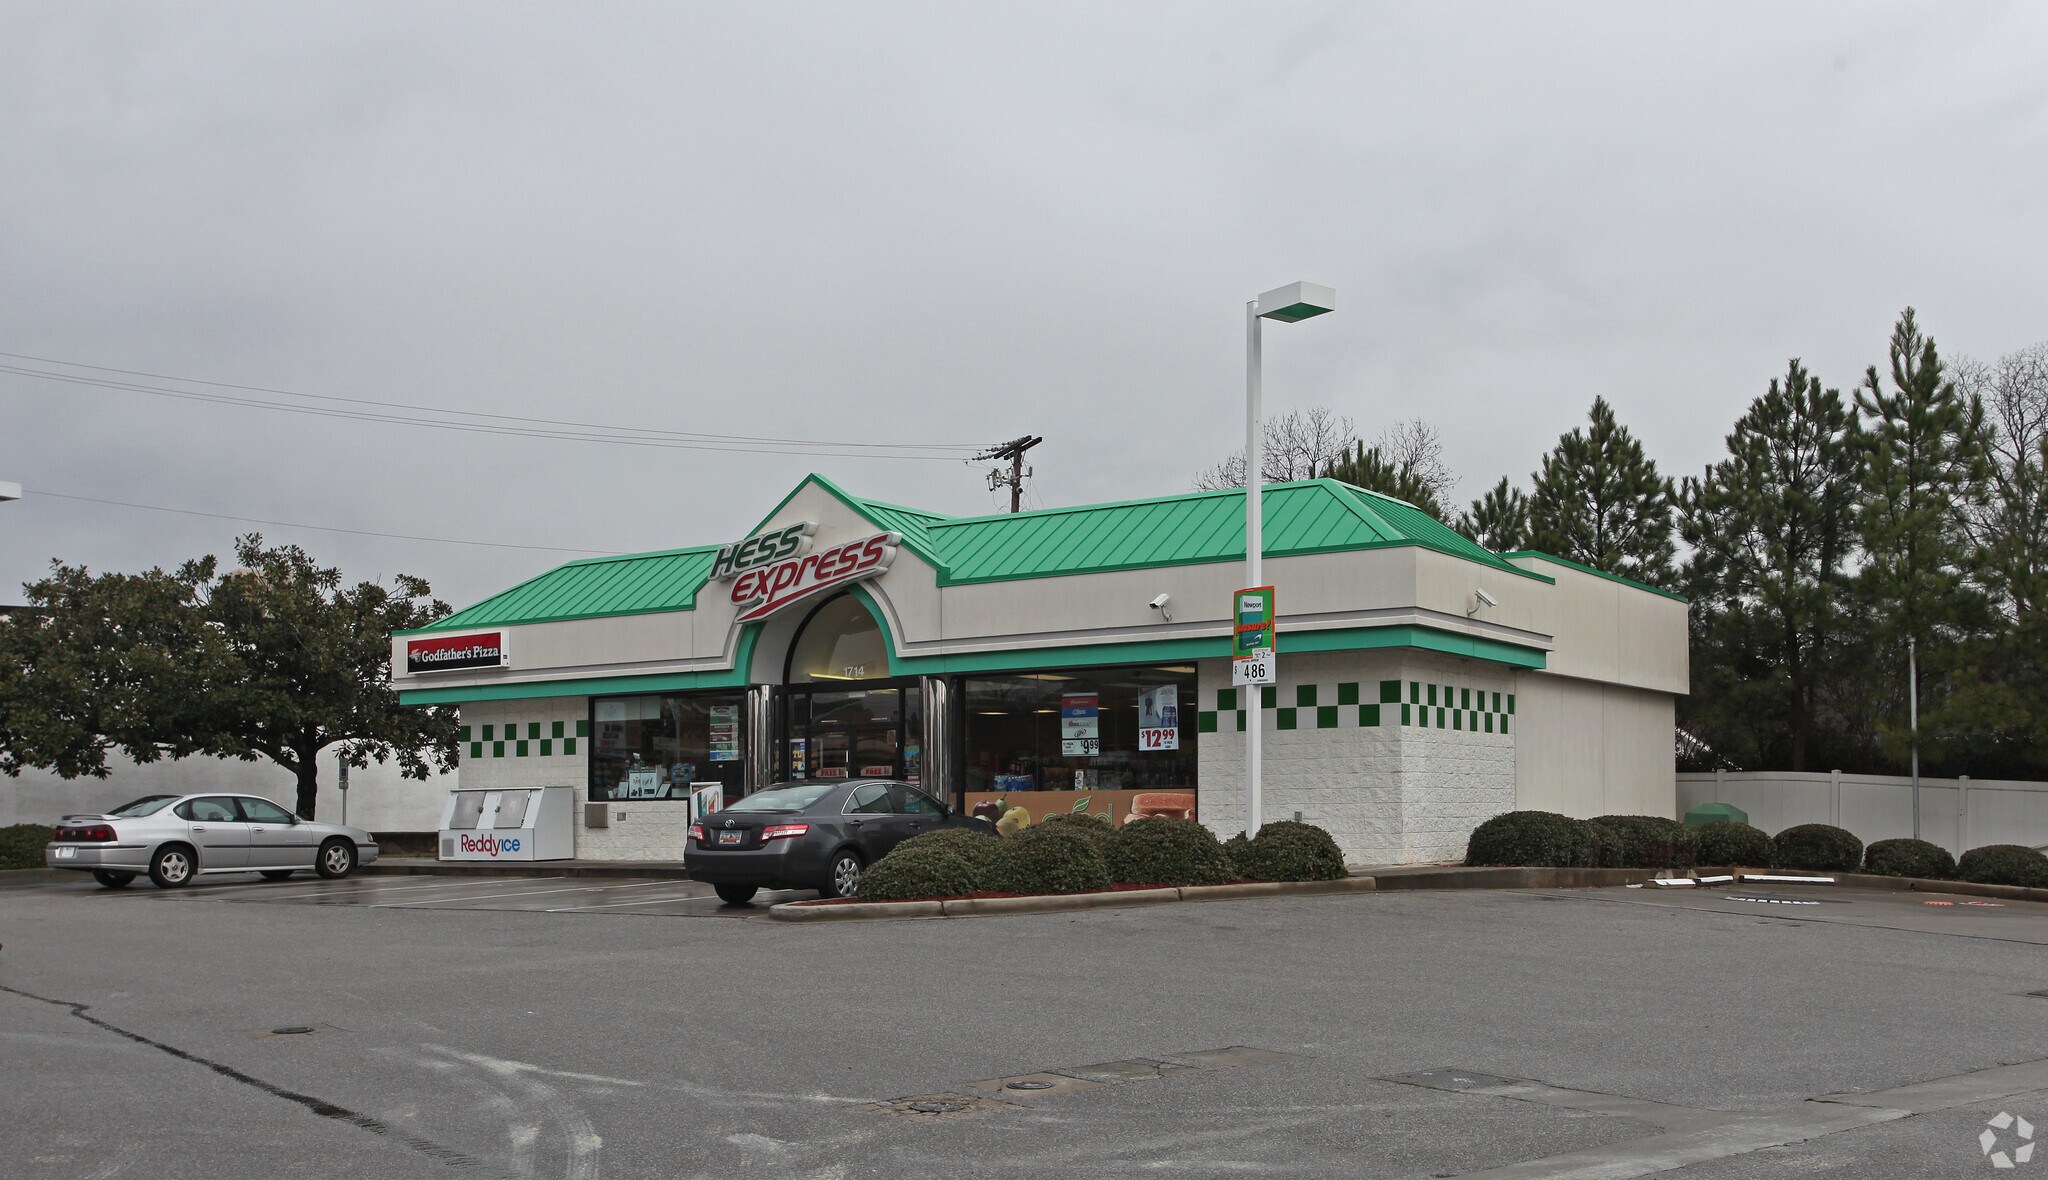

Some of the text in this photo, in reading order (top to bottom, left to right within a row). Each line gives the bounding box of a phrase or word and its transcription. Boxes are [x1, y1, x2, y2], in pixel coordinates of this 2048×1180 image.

[709, 523, 806, 578] HESS
[731, 534, 889, 604] EXPRESS
[1243, 601, 1262, 609] Newport
[421, 645, 499, 663] Godfather's Pizza
[842, 665, 865, 678] 1714
